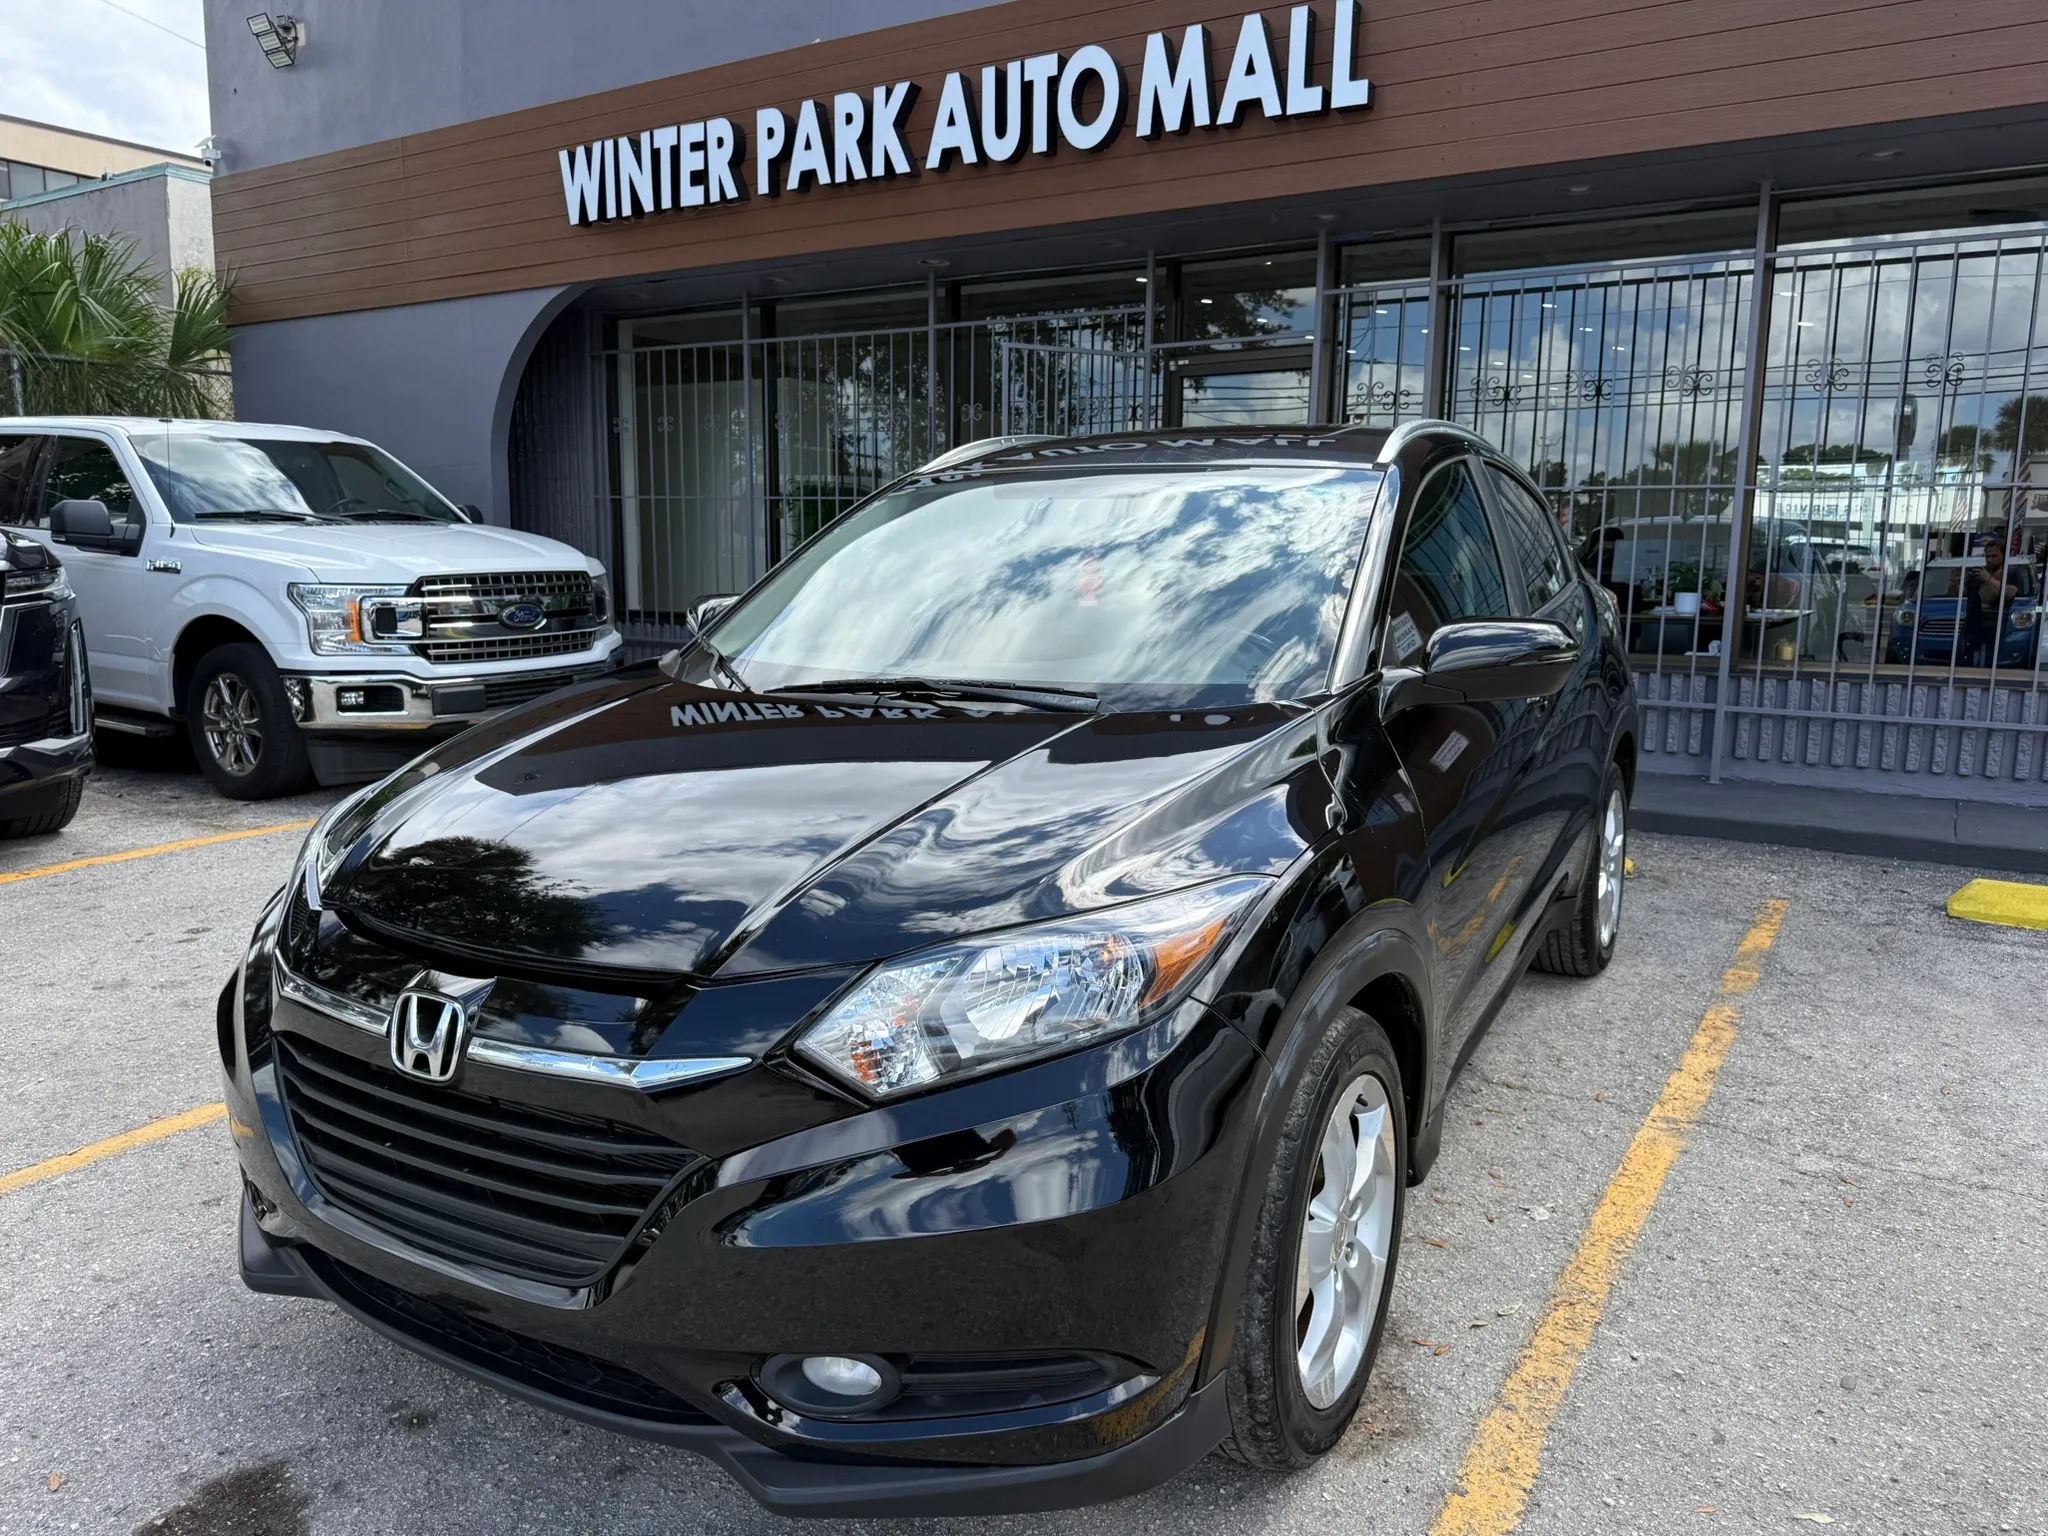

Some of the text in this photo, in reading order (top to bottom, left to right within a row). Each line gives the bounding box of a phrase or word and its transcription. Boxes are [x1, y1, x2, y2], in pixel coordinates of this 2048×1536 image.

[558, 0, 1371, 227] WINTER PARK AUTO MALL
